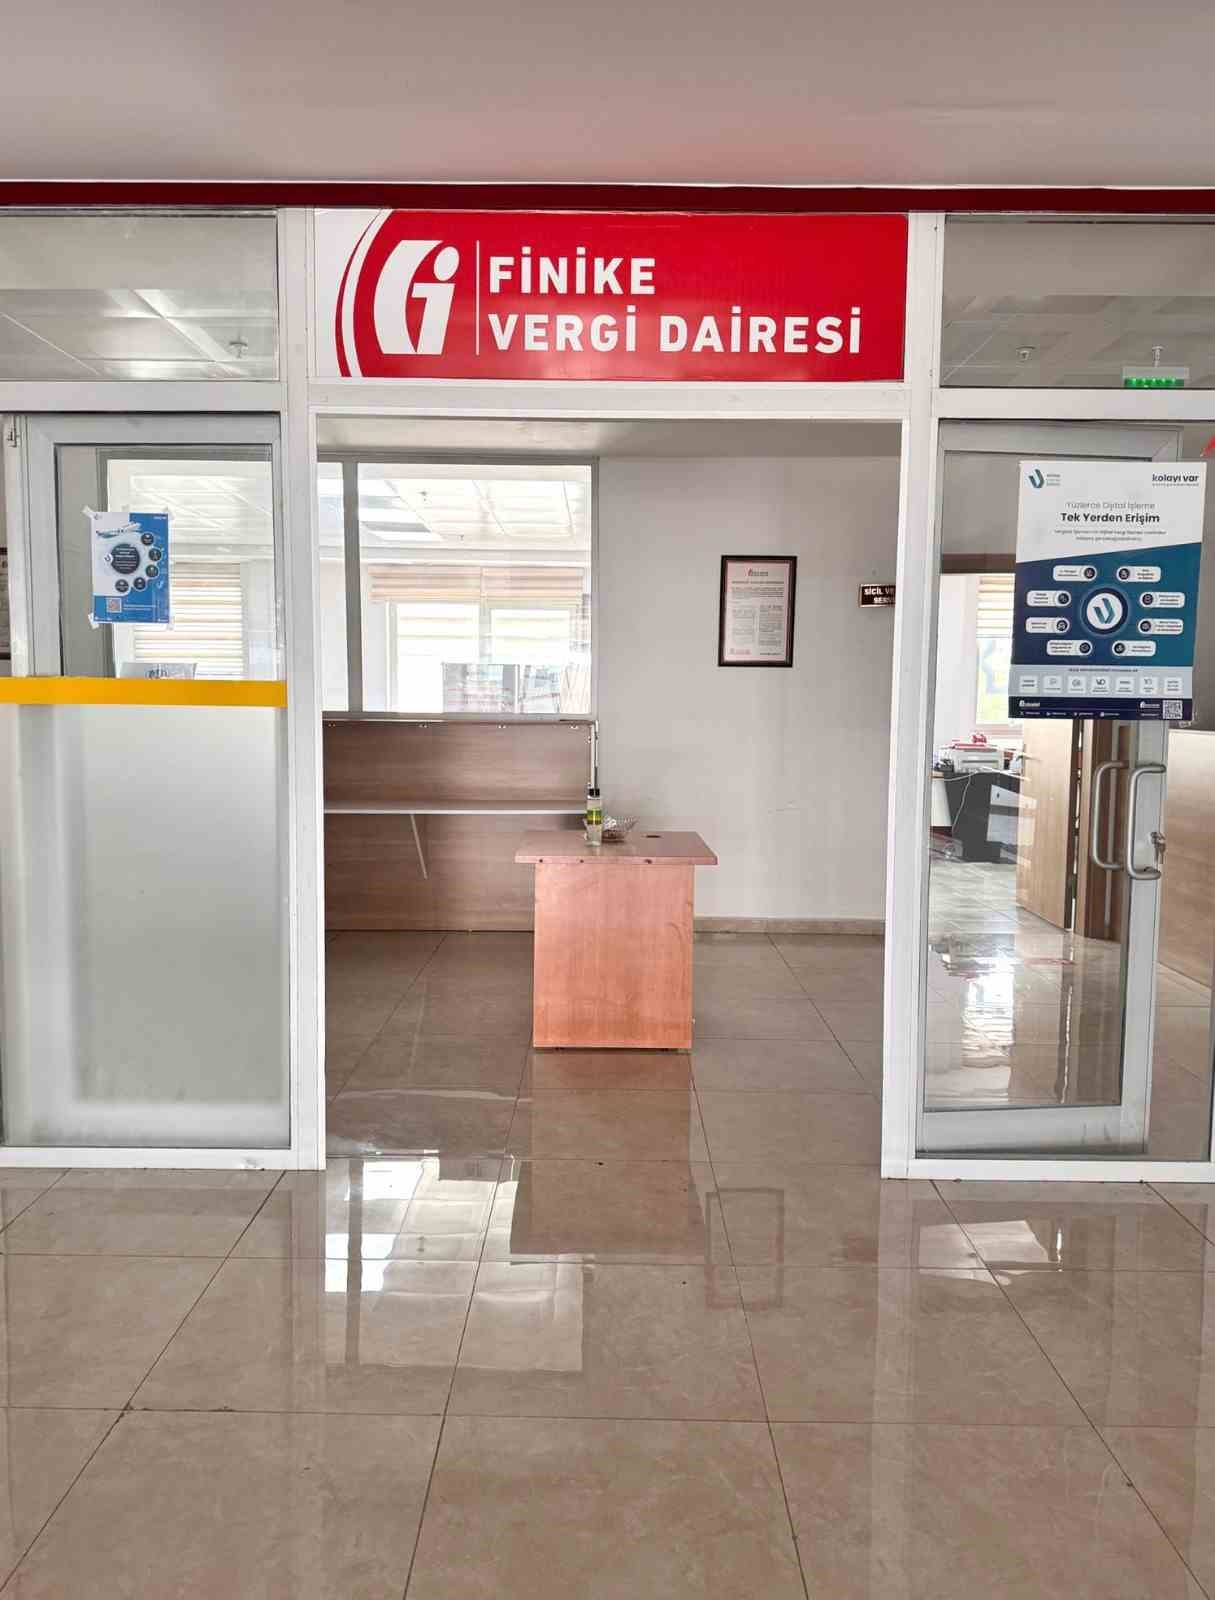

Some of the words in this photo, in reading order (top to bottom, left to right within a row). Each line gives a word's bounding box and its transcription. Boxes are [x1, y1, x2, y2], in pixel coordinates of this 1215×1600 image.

[489, 246, 656, 295] FİNİKE
[488, 305, 637, 352] VERGİ
[660, 306, 861, 353] DAİRESİ
[1060, 512, 1080, 522] Tek
[1083, 512, 1123, 522] Yerden
[1125, 513, 1160, 525] Erişim
